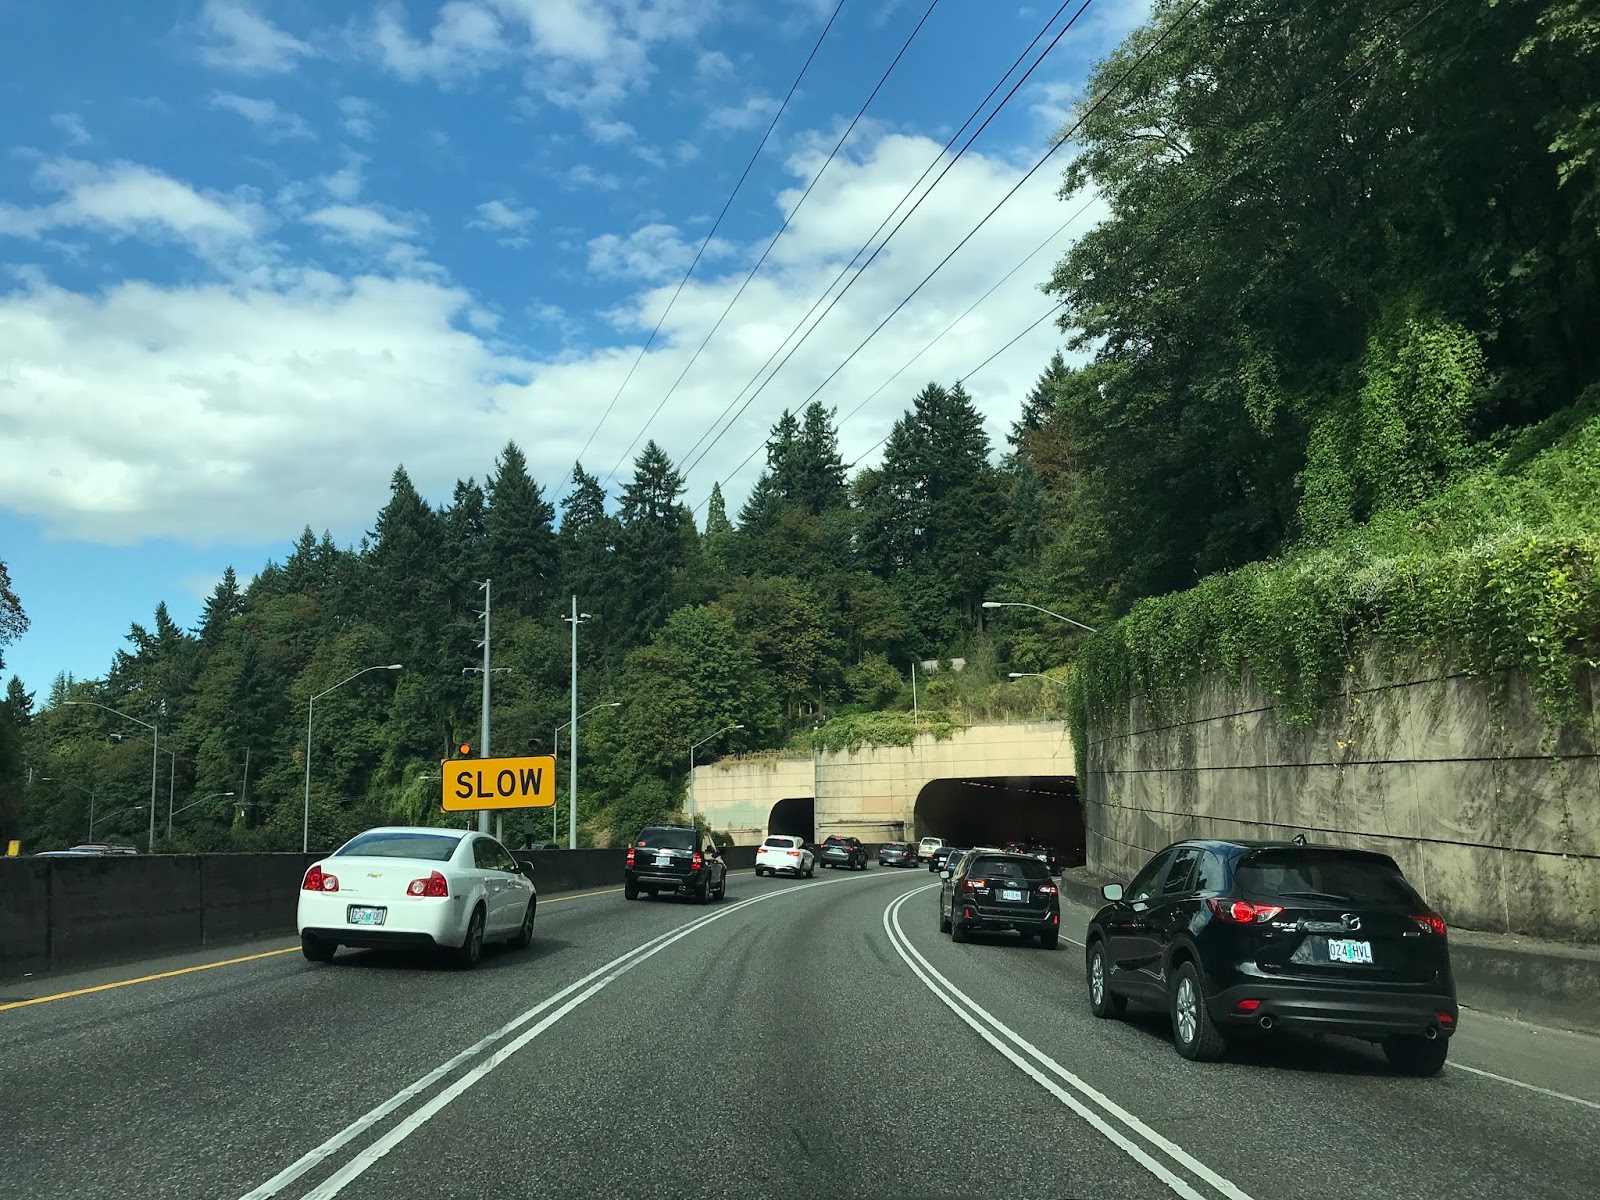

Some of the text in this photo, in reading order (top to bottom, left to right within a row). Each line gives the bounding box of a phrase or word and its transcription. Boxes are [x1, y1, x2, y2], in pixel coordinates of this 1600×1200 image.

[455, 768, 542, 799] SLOW
[1330, 943, 1371, 958] 024 HVL
